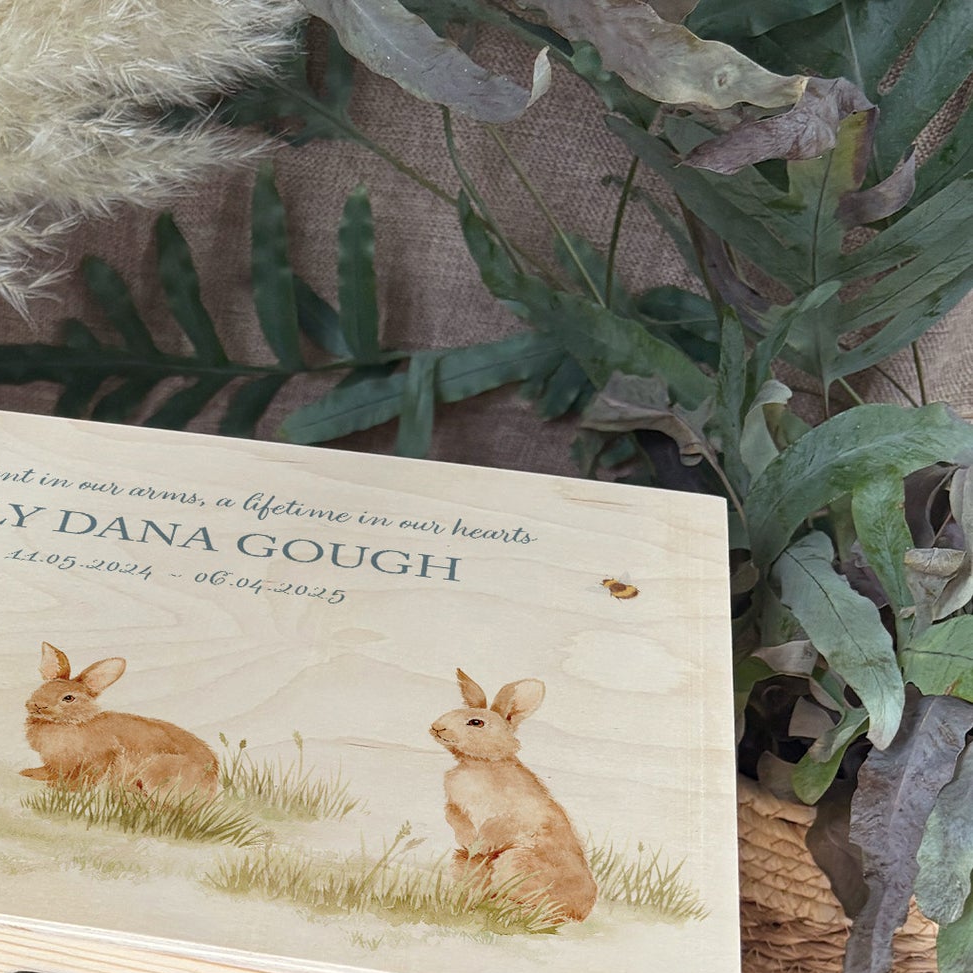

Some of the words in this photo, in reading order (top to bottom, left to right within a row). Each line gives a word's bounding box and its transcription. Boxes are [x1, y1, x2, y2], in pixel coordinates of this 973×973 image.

[38, 472, 75, 489] in
[78, 479, 125, 496] our
[128, 485, 205, 508] arms,
[215, 496, 235, 508] a
[242, 491, 353, 524] lifetime
[358, 510, 394, 528] in
[399, 518, 445, 536] our
[451, 518, 539, 546] hearts
[52, 509, 219, 552] DANA
[236, 533, 462, 582] GOUGH
[4, 548, 153, 582] 11.05.2024
[194, 569, 347, 605] 06.04.2025
